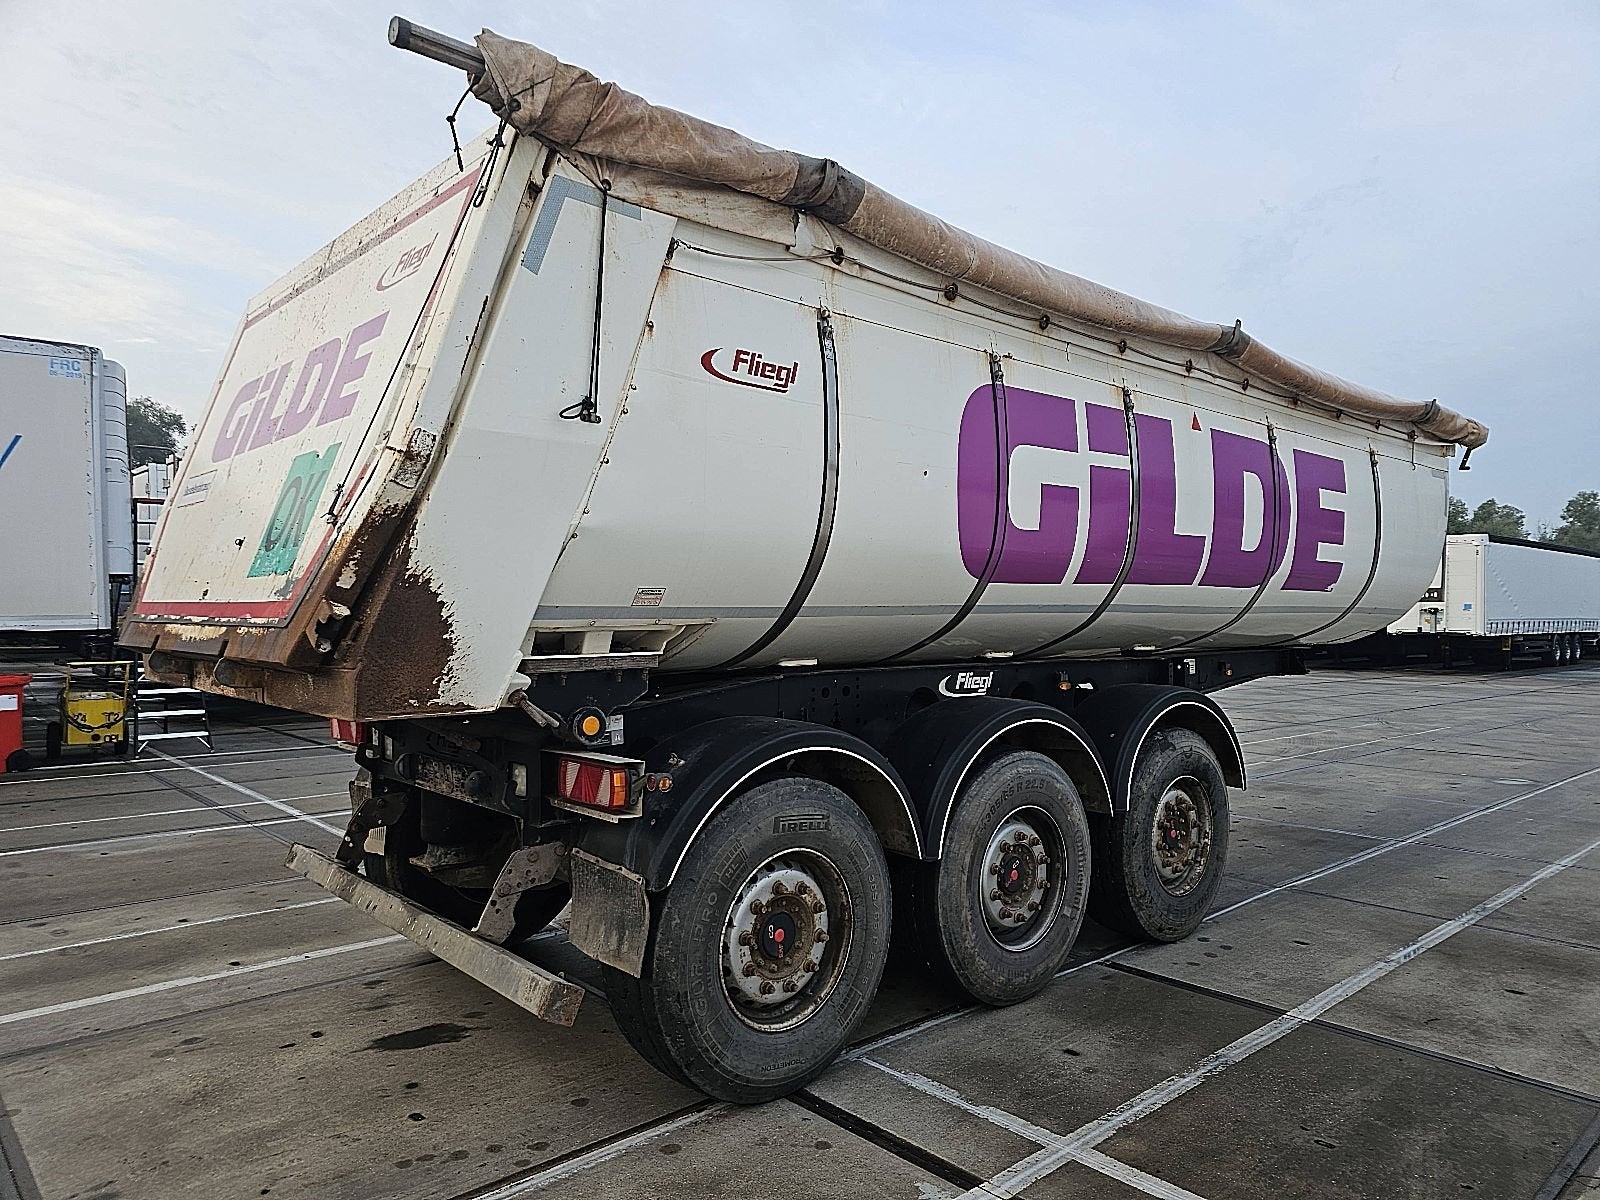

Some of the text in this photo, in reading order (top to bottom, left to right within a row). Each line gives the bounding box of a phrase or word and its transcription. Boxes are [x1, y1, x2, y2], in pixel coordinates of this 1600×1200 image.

[391, 232, 439, 279] Fliegl
[49, 357, 81, 371] FRC
[731, 348, 799, 388] Fliegl
[263, 469, 328, 553] OK
[955, 671, 994, 692] Fliegl
[772, 813, 832, 833] PIRELLI
